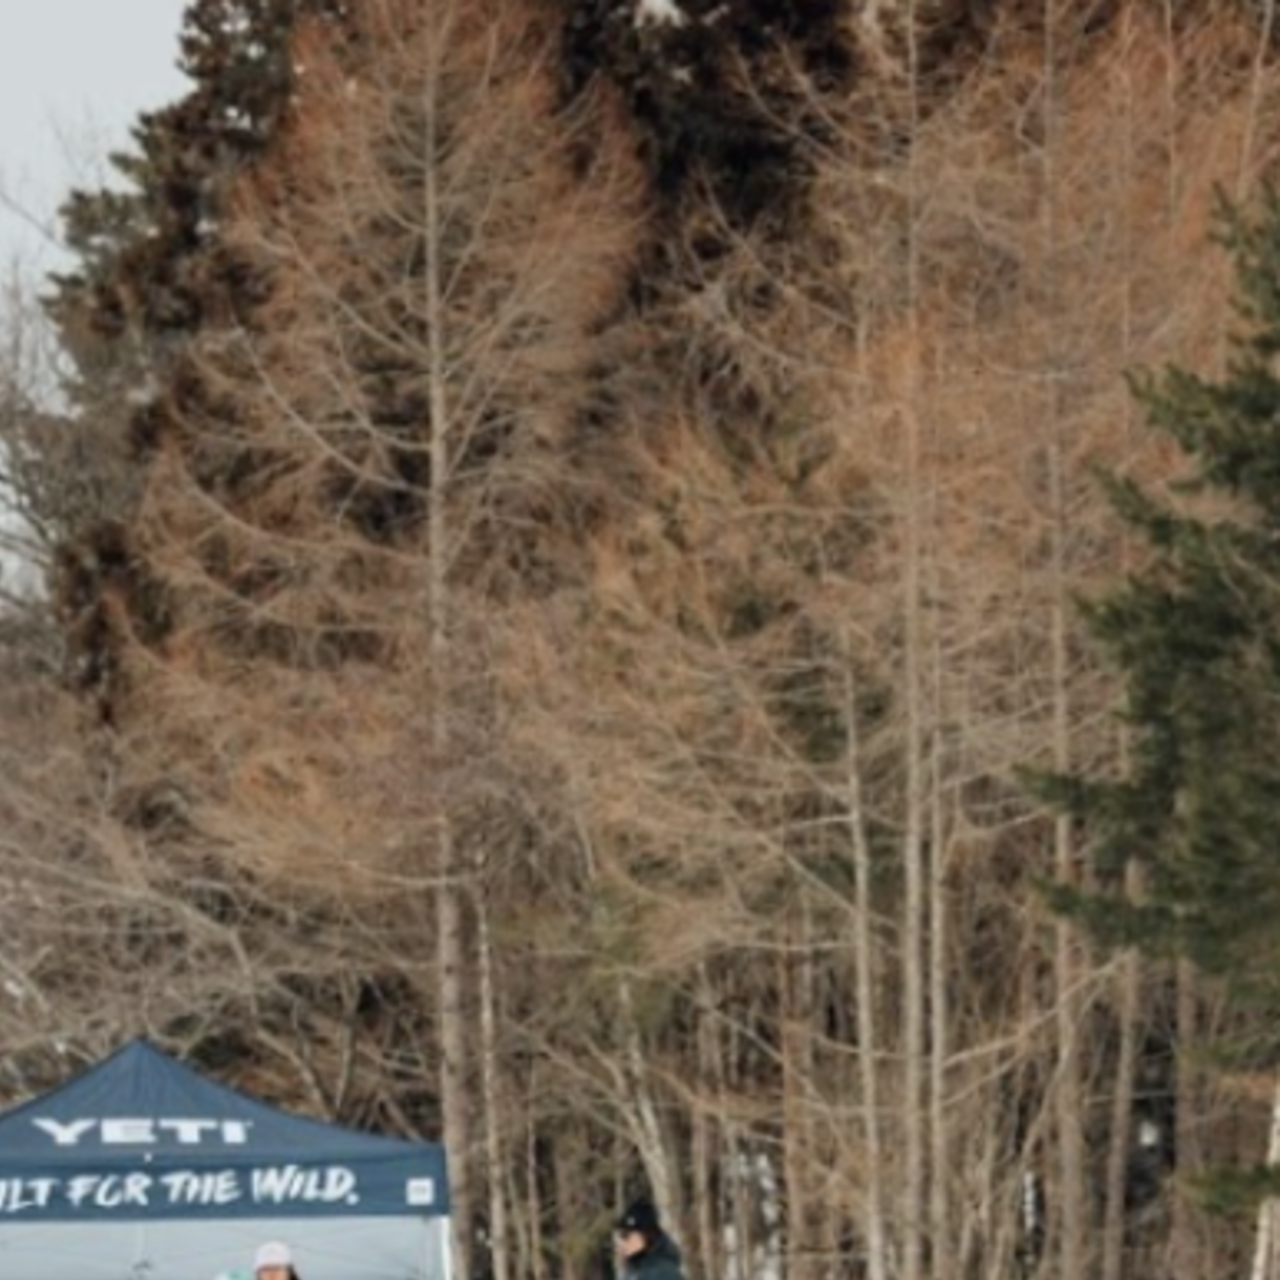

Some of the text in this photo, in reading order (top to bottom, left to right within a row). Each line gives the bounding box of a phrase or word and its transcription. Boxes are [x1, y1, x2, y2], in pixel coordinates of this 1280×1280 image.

[32, 1116, 250, 1146] YETI
[66, 1172, 153, 1209] FOR
[158, 1168, 240, 1204] THE
[251, 1163, 361, 1206] WILD.
